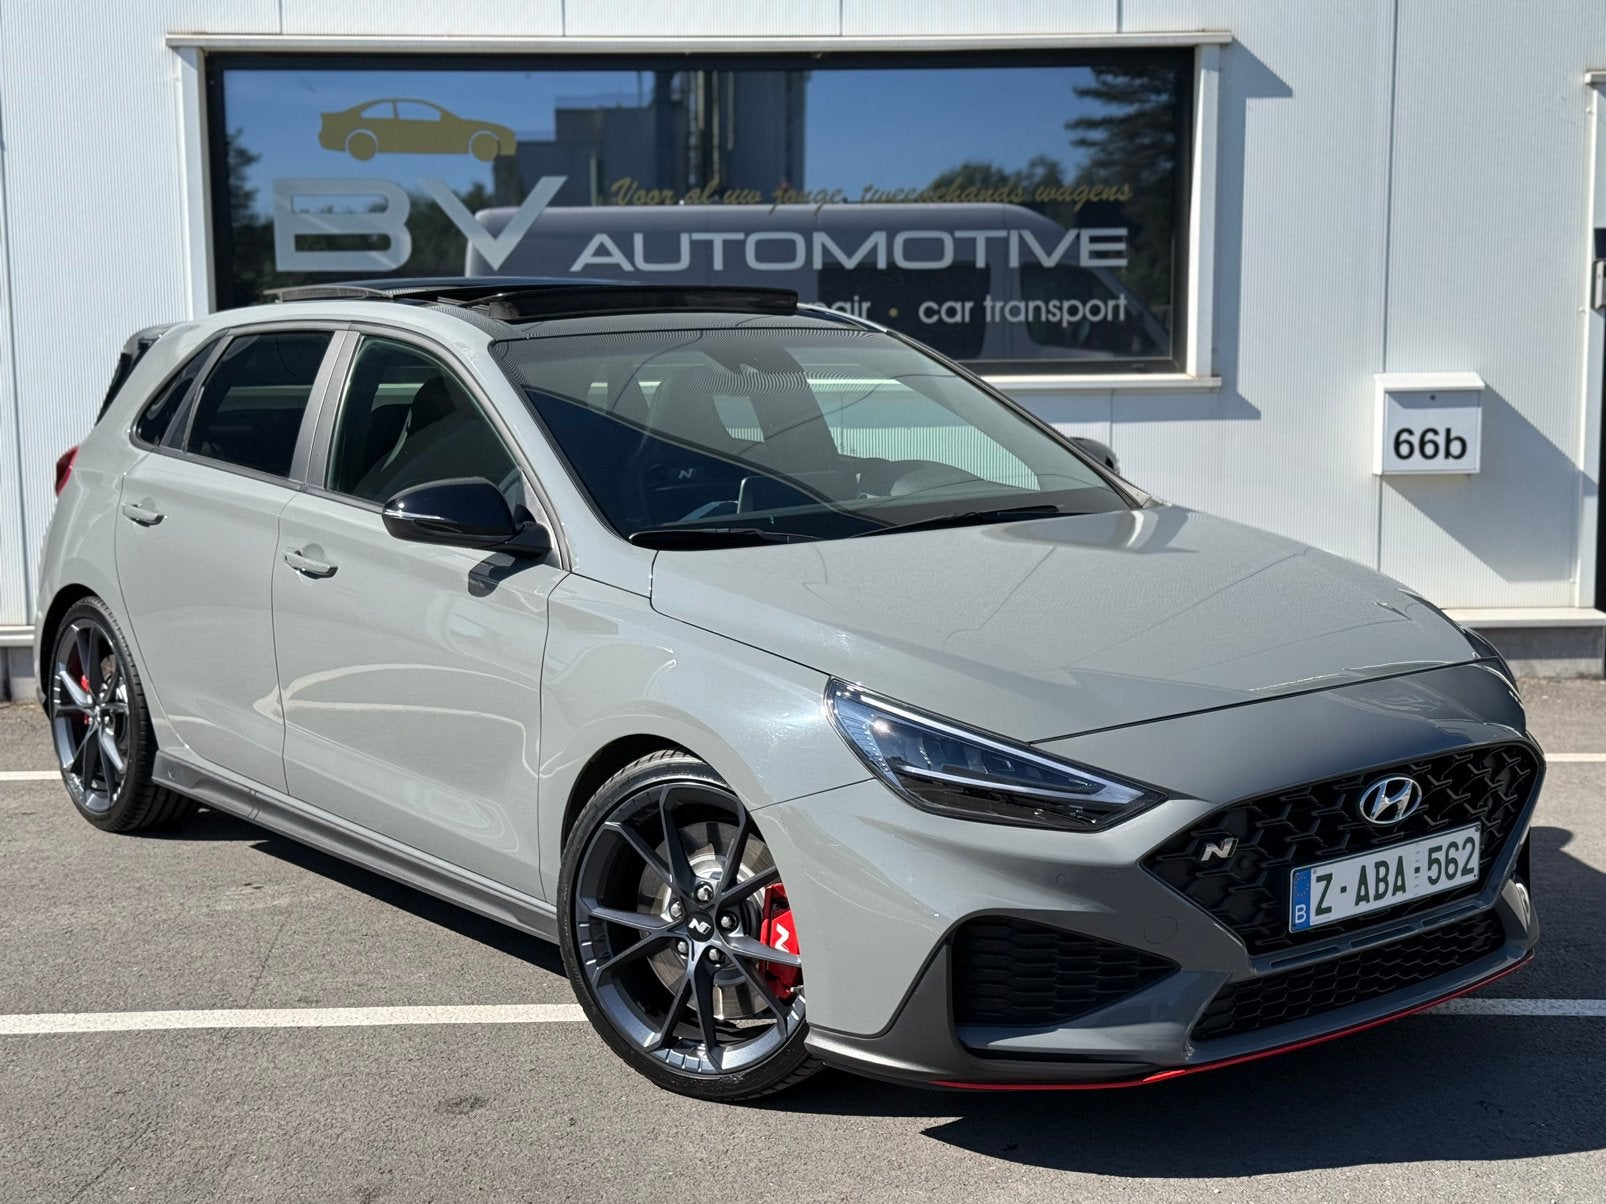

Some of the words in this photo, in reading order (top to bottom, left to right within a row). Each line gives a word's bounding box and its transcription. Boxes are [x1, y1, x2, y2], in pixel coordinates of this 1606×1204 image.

[611, 176, 675, 206] Voor
[1034, 181, 1134, 213] wagens
[273, 175, 568, 273] BV
[569, 227, 1129, 272] AUTOMOTIVE
[918, 300, 974, 324] car
[983, 293, 1128, 329] transport
[1393, 427, 1467, 460] 66b
[1295, 904, 1307, 924] B
